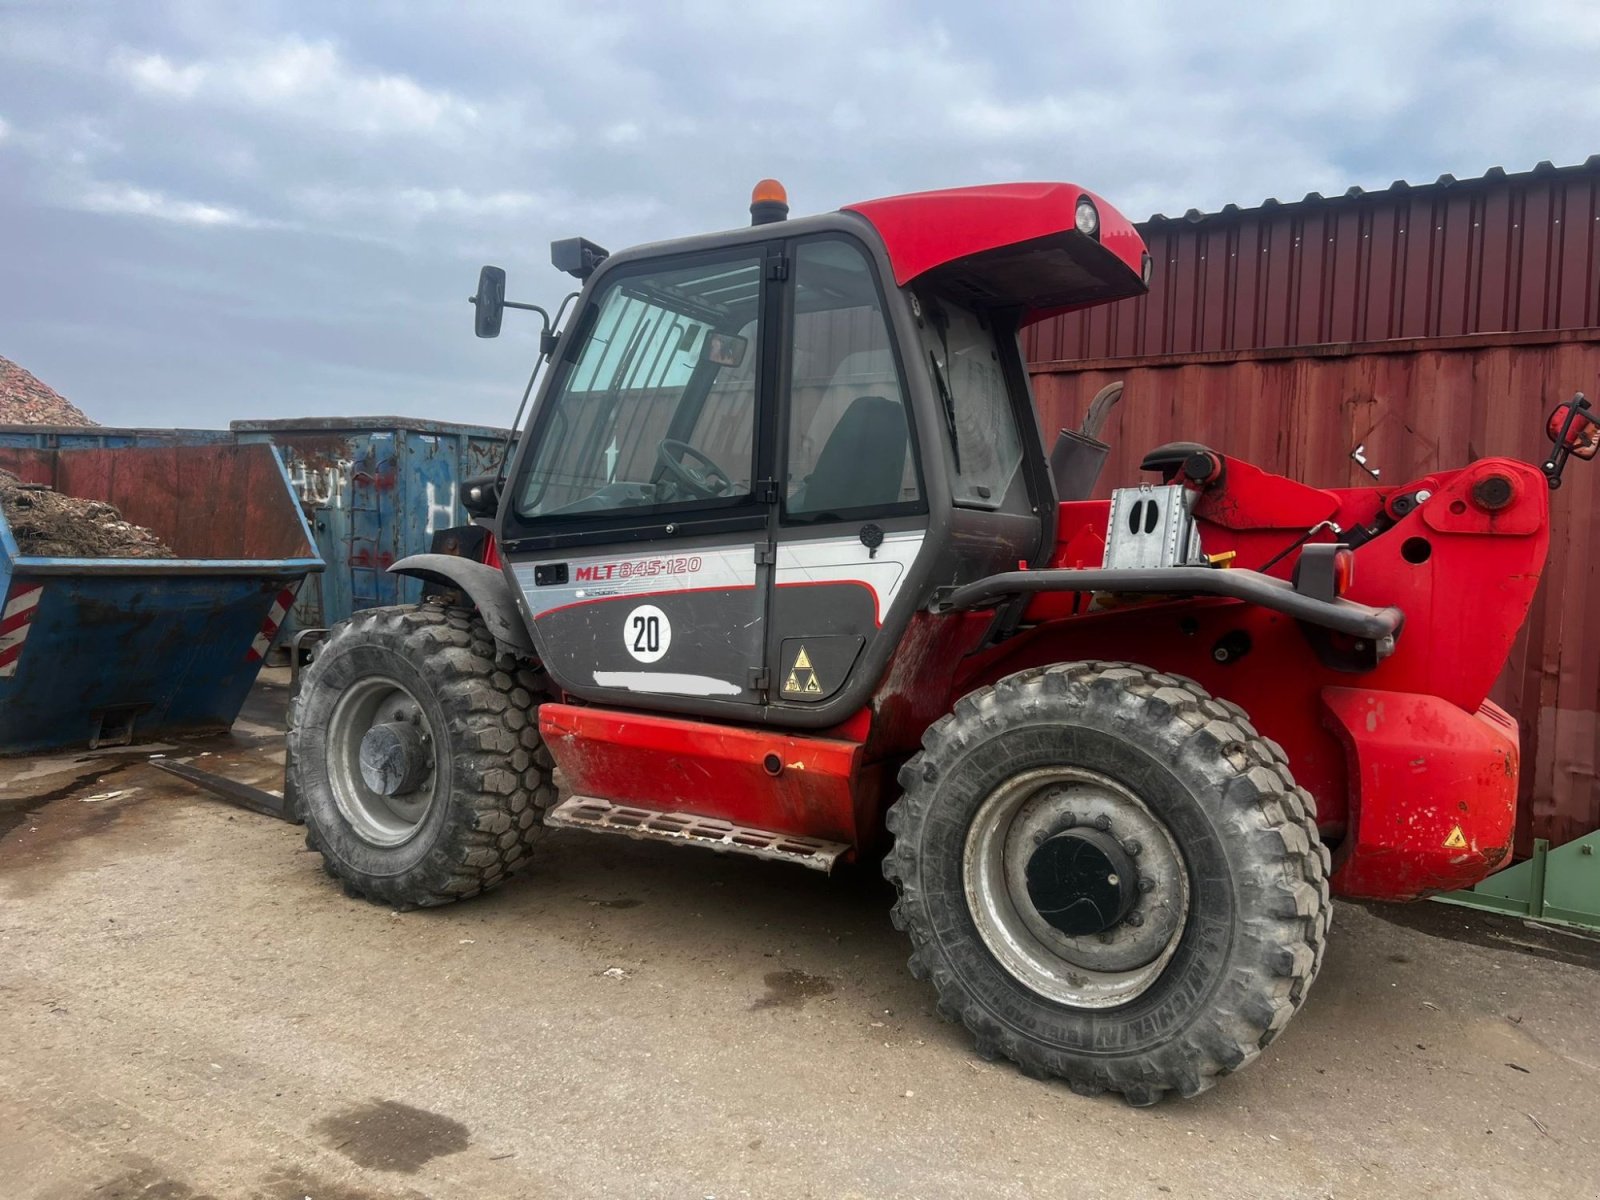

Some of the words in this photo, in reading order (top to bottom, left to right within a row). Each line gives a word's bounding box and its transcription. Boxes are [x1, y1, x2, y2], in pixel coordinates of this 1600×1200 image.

[426, 482, 456, 534] H
[576, 565, 616, 581] MLT
[619, 557, 702, 579] 845-120
[633, 616, 659, 652] 20
